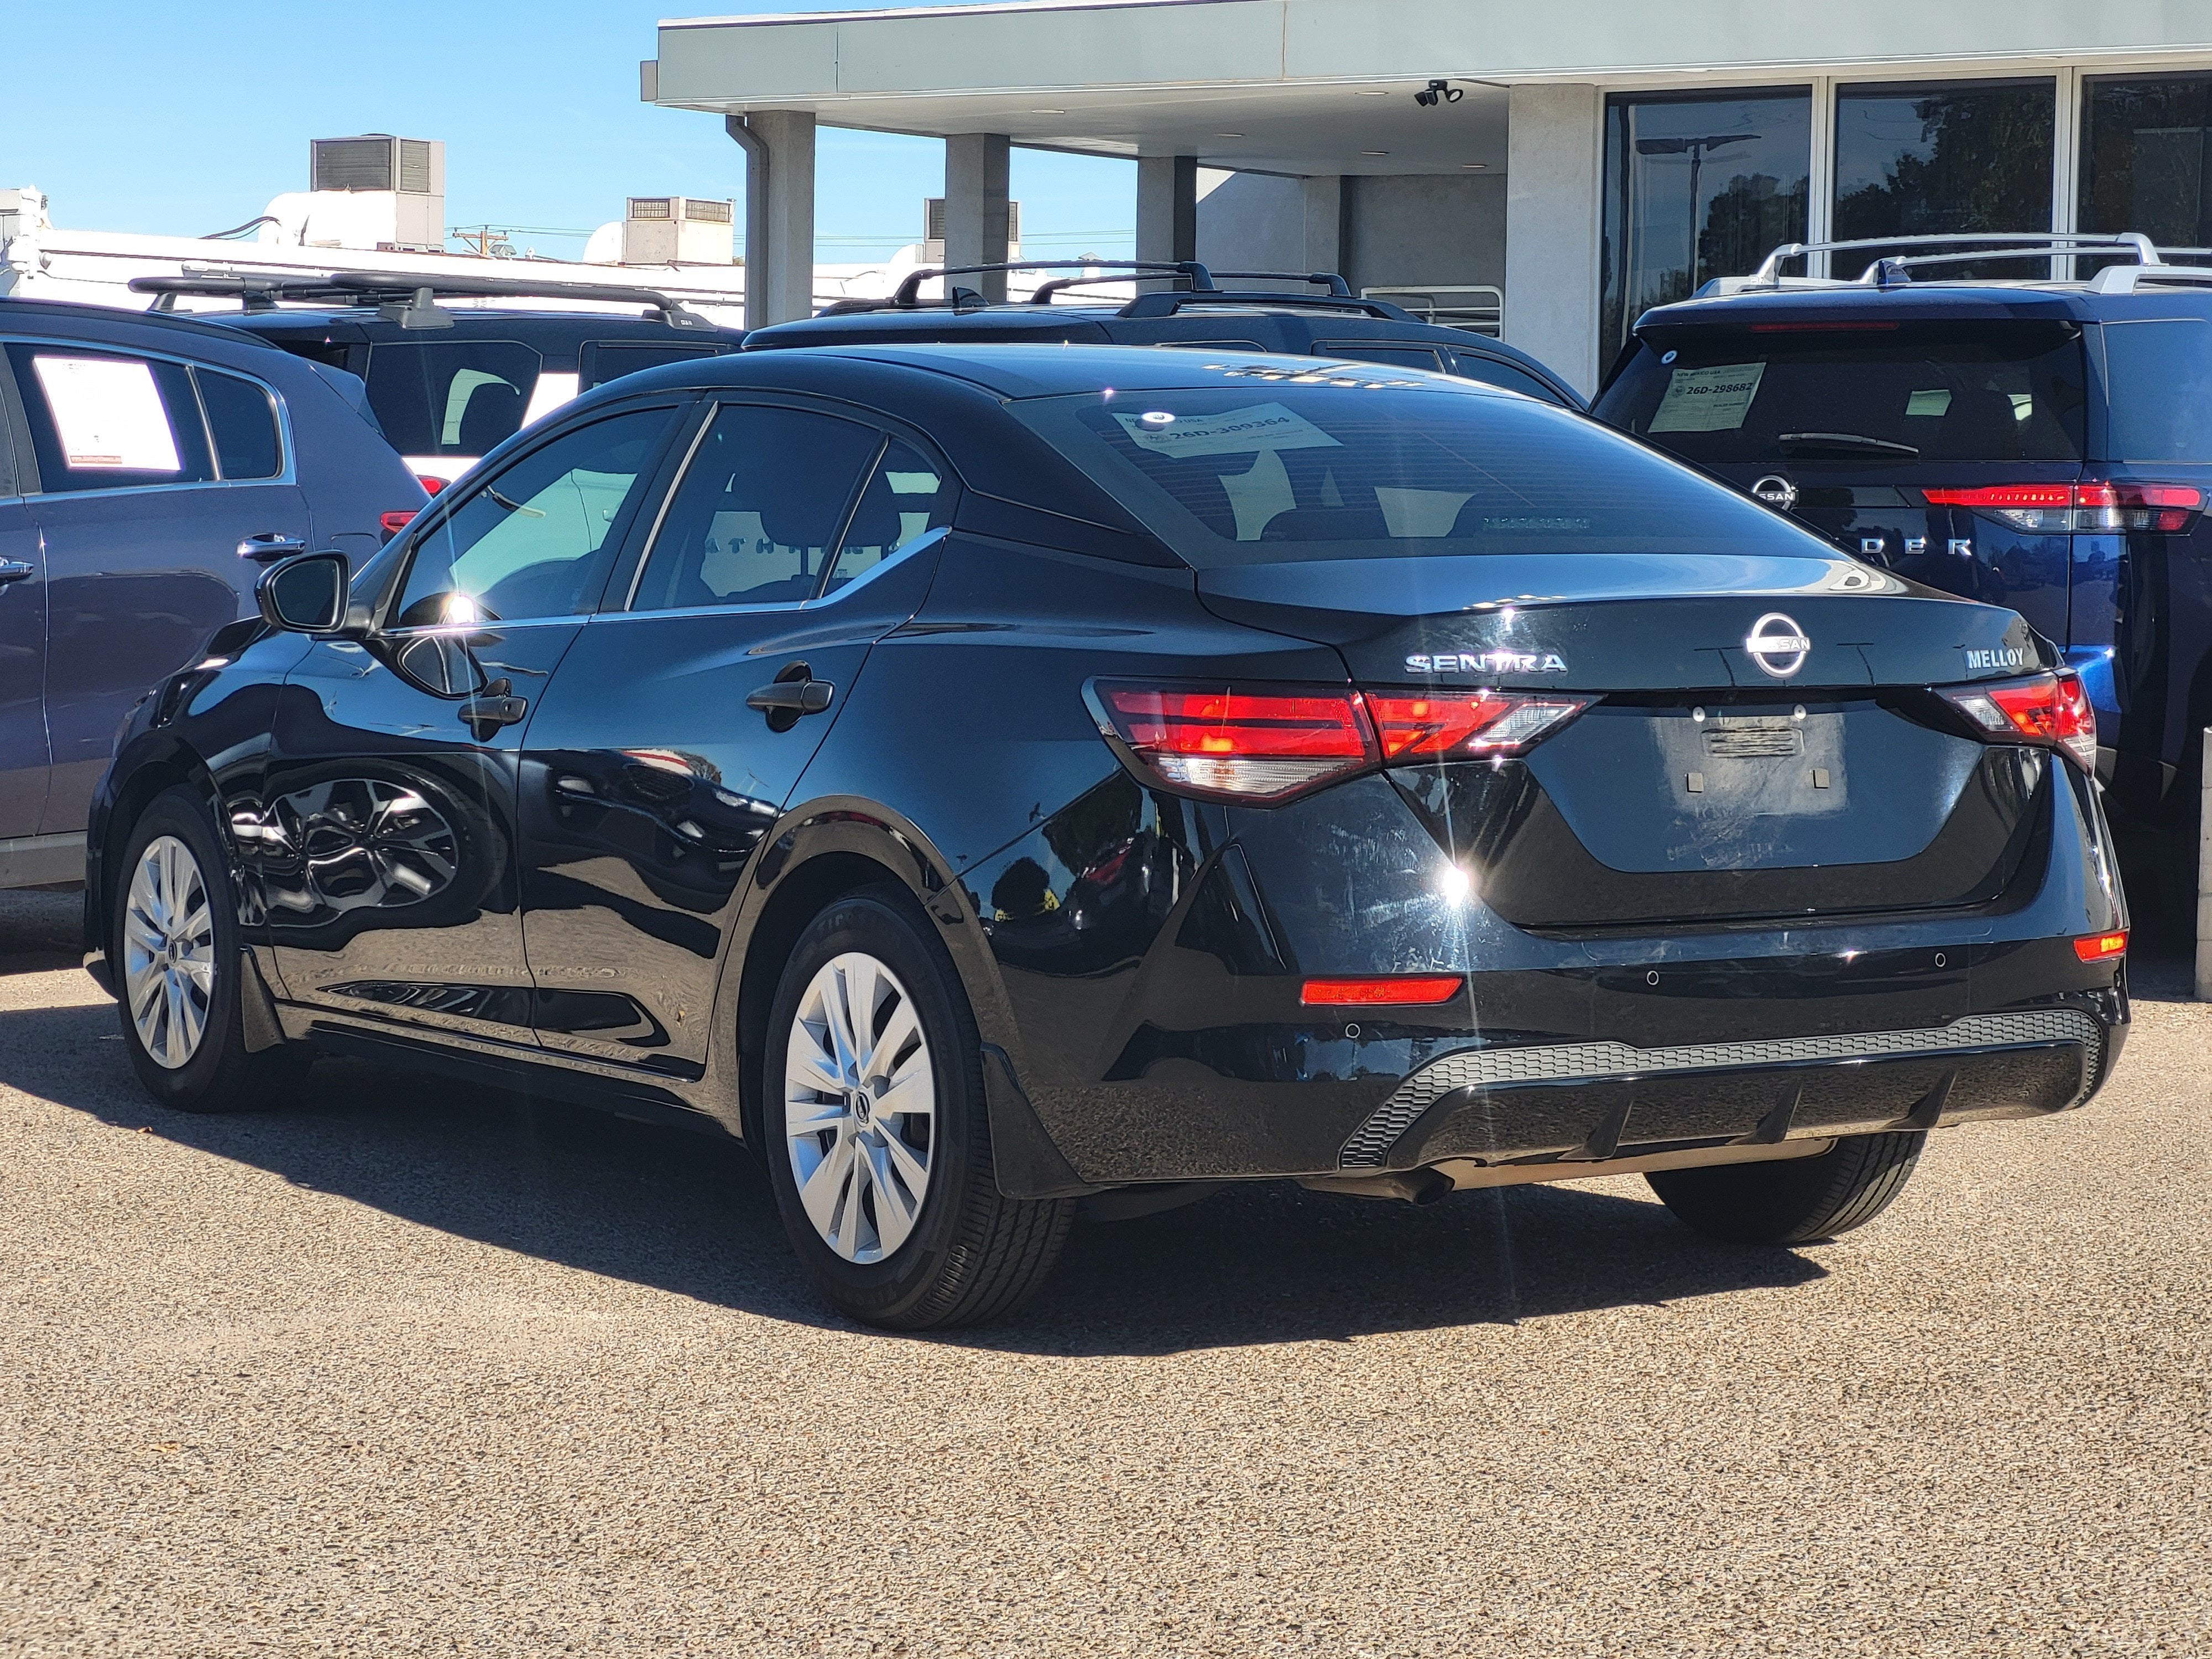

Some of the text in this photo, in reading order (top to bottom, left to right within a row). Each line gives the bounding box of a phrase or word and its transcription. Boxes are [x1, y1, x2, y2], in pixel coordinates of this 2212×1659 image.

[1687, 382, 1754, 395] 26D-298682
[1169, 416, 1290, 439] 26D-309364
[1405, 652, 1568, 673] SENTRA
[1966, 647, 2023, 670] MELLOY
